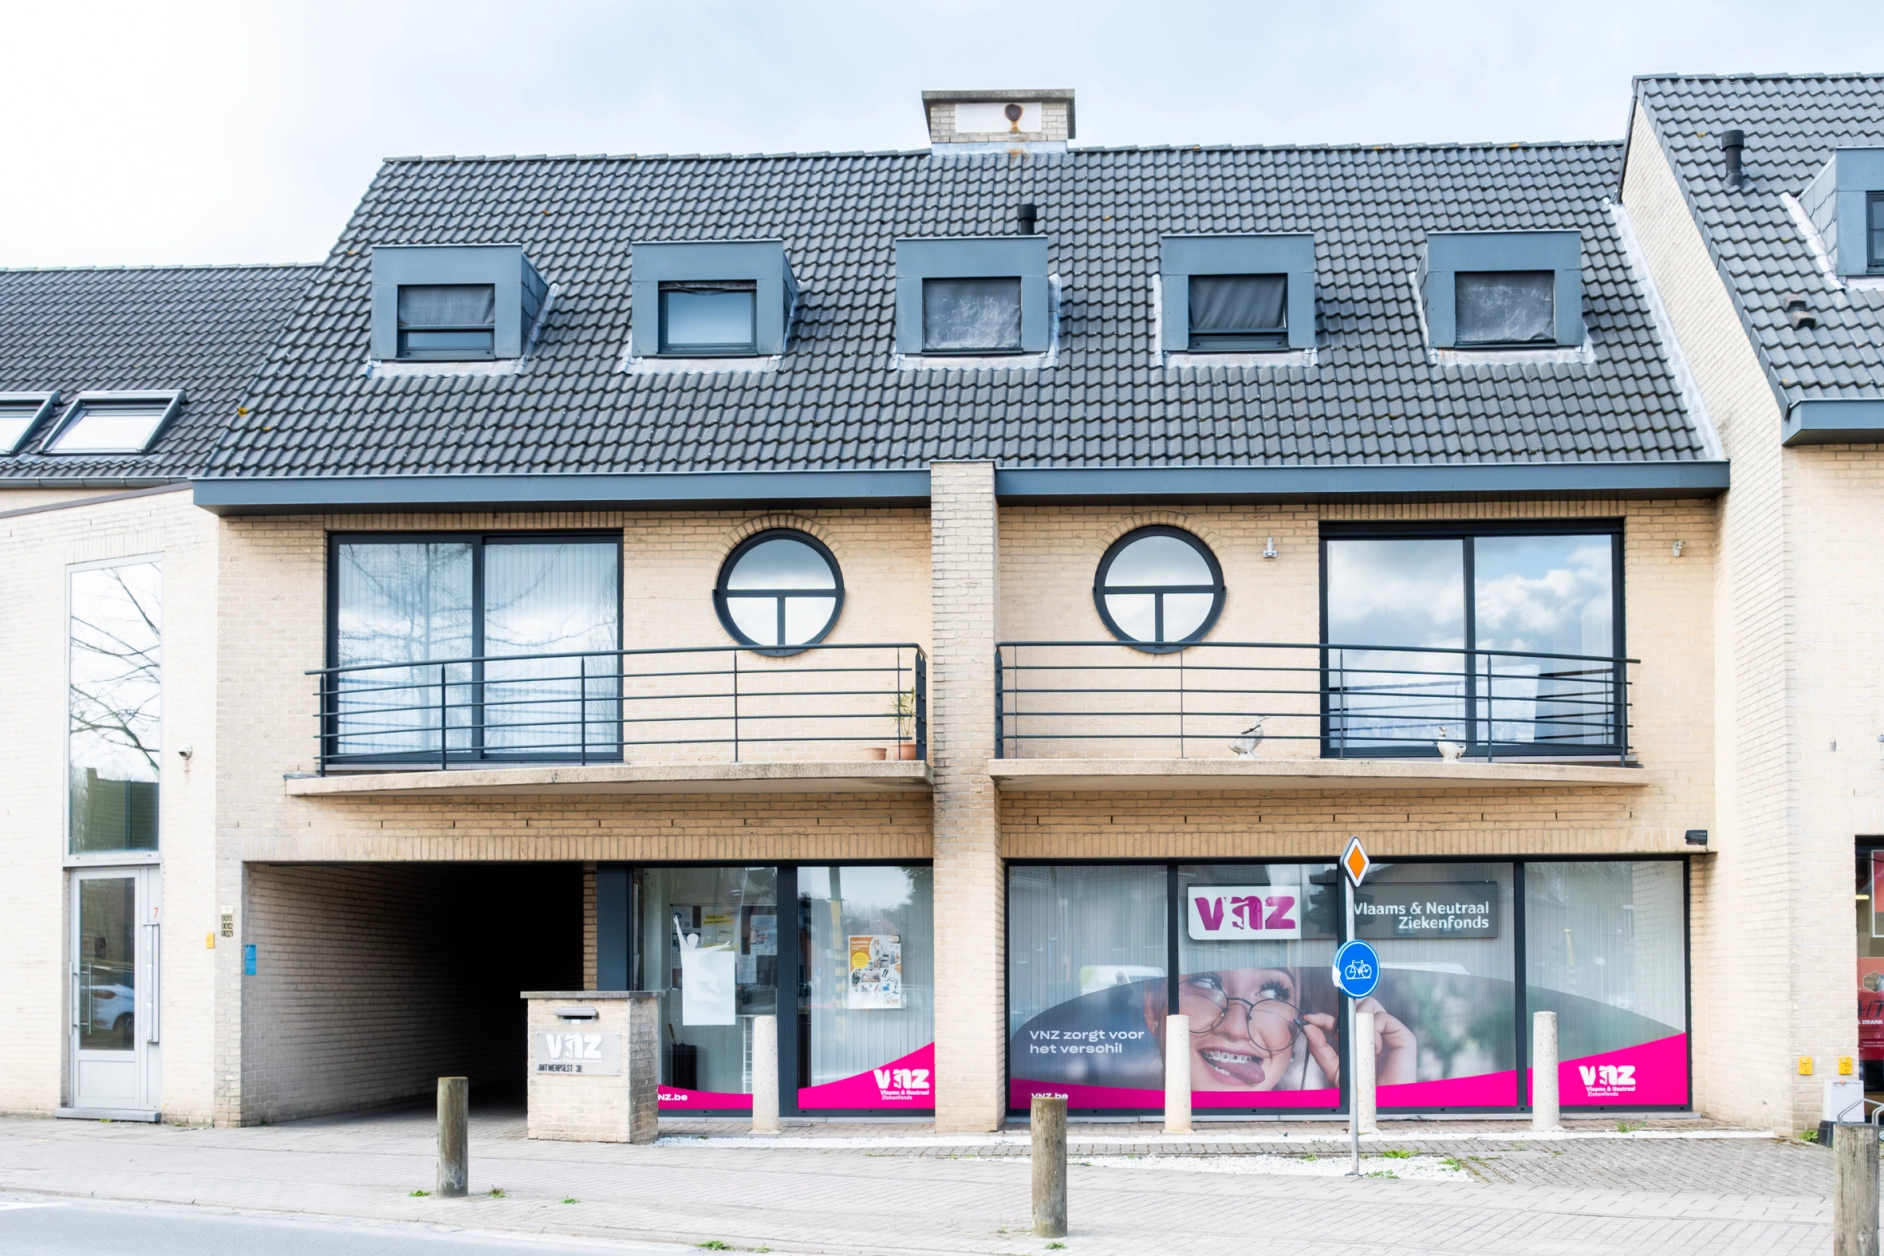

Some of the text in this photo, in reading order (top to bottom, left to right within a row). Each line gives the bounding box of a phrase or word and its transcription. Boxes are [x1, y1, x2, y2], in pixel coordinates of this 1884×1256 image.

[153, 907, 159, 918] 7
[1354, 901, 1489, 915] Vlaams & Neutraal
[1398, 916, 1489, 929] Ziekenfonds
[1029, 1030, 1145, 1042] VNZ zorgt voor
[1029, 1042, 1123, 1054] het verschil
[658, 1093, 688, 1101] NZ.be
[1031, 1092, 1069, 1100] VNZbe
